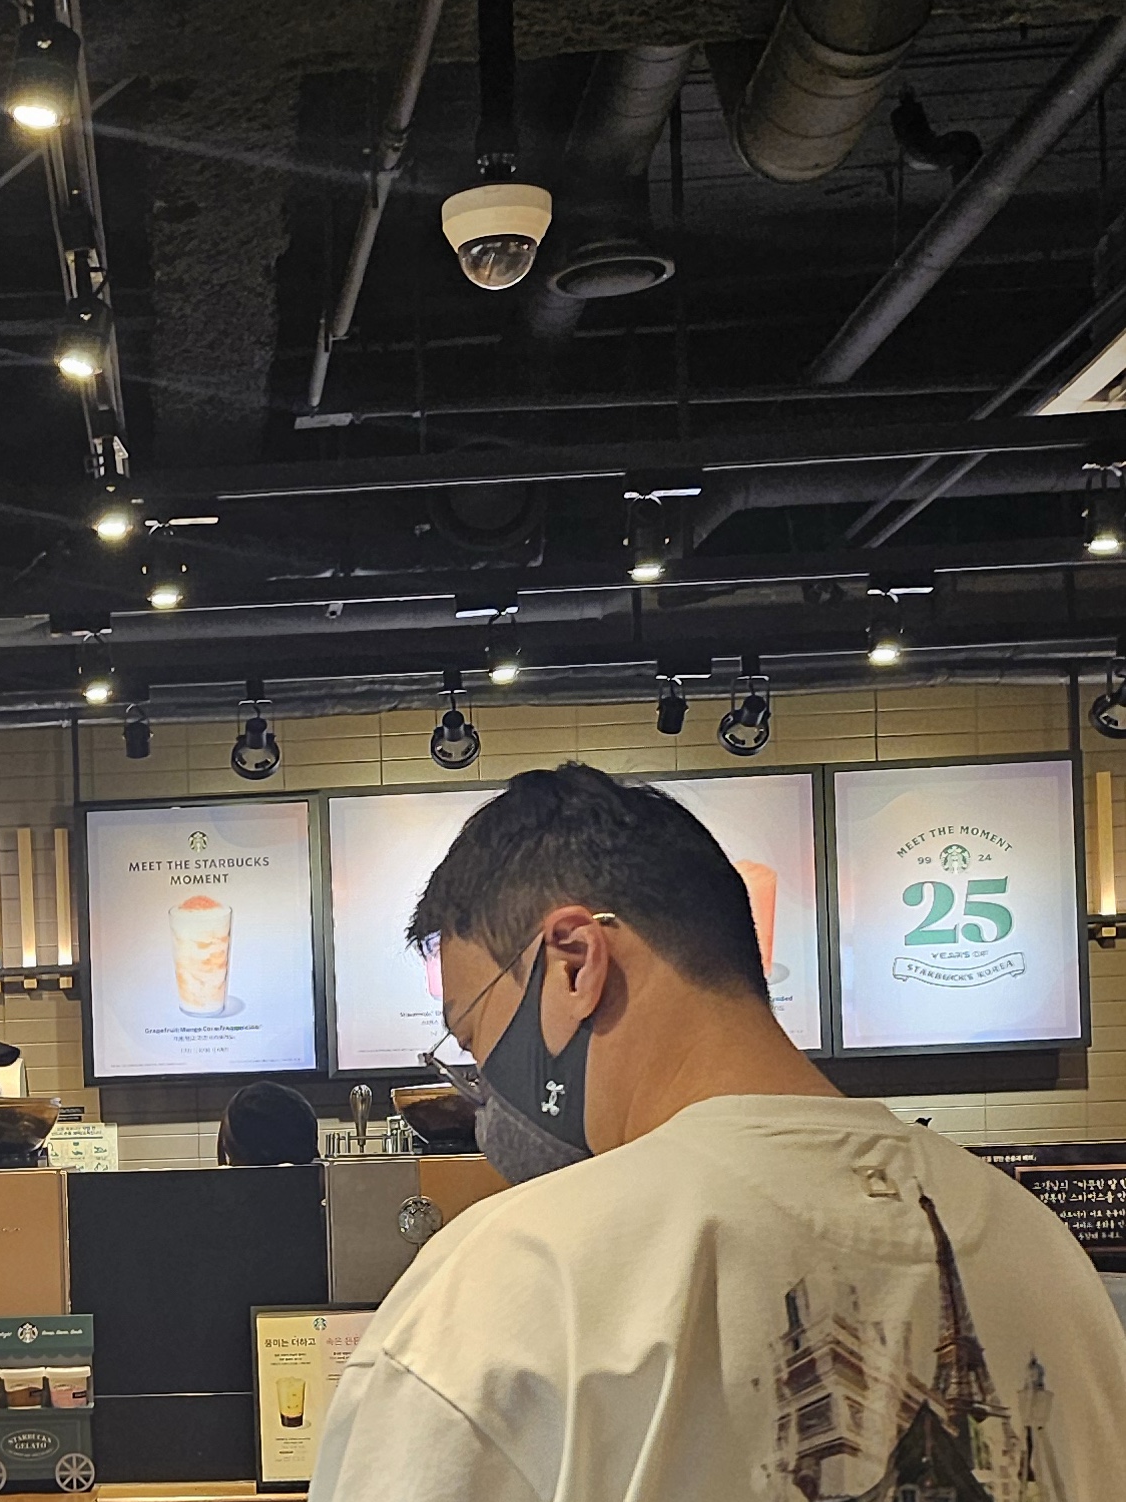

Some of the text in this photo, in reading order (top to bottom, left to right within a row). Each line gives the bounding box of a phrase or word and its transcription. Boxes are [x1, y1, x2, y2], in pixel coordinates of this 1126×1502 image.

[896, 825, 1013, 858] MEET THE MOMENT
[128, 856, 270, 872] MEET THE STARBUCKS
[917, 856, 932, 865] 99
[978, 854, 992, 862] 24
[170, 873, 230, 886] MOMENT
[902, 875, 1013, 947] 25
[931, 950, 989, 960] YEARS OF
[907, 959, 1014, 982] STARBUCKS KOREA
[144, 1027, 179, 1035] Grapefruit
[264, 1338, 289, 1348] 풍미는
[291, 1336, 316, 1347] 더하고
[8, 1432, 52, 1445] STARBUCKS
[14, 1442, 47, 1450] GELATO
